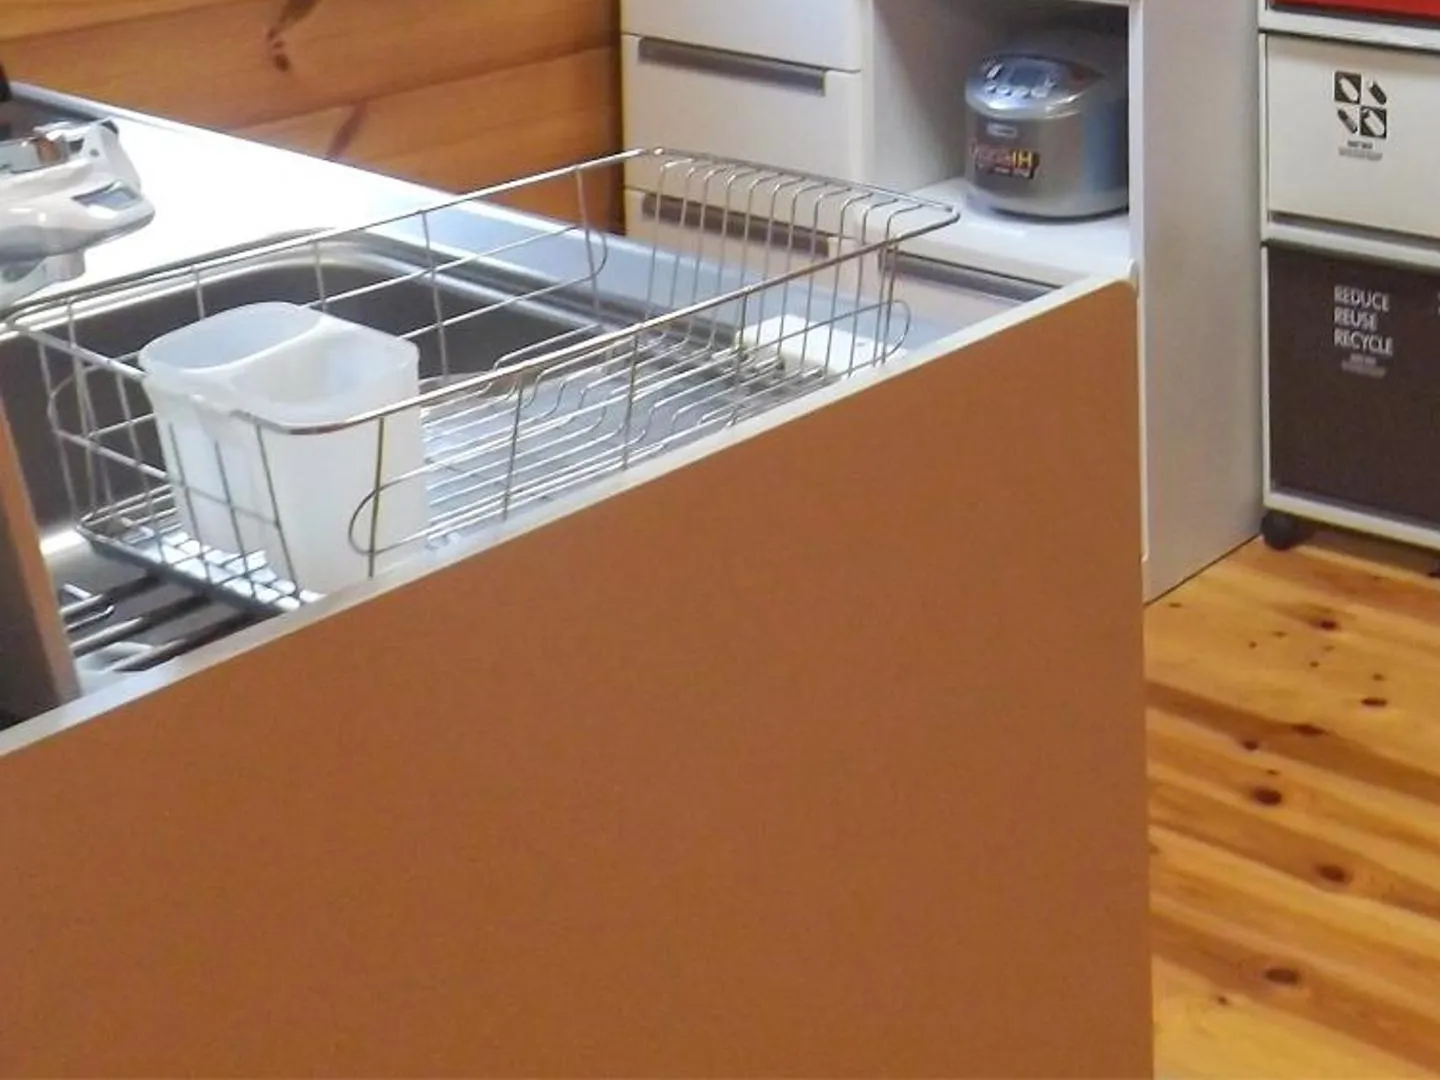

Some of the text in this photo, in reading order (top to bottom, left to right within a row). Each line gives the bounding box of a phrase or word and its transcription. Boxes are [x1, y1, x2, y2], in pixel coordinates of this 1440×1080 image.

[1334, 285, 1390, 312] REDUCE
[1334, 306, 1378, 332] REUSE
[1334, 328, 1394, 356] RECYCLE
